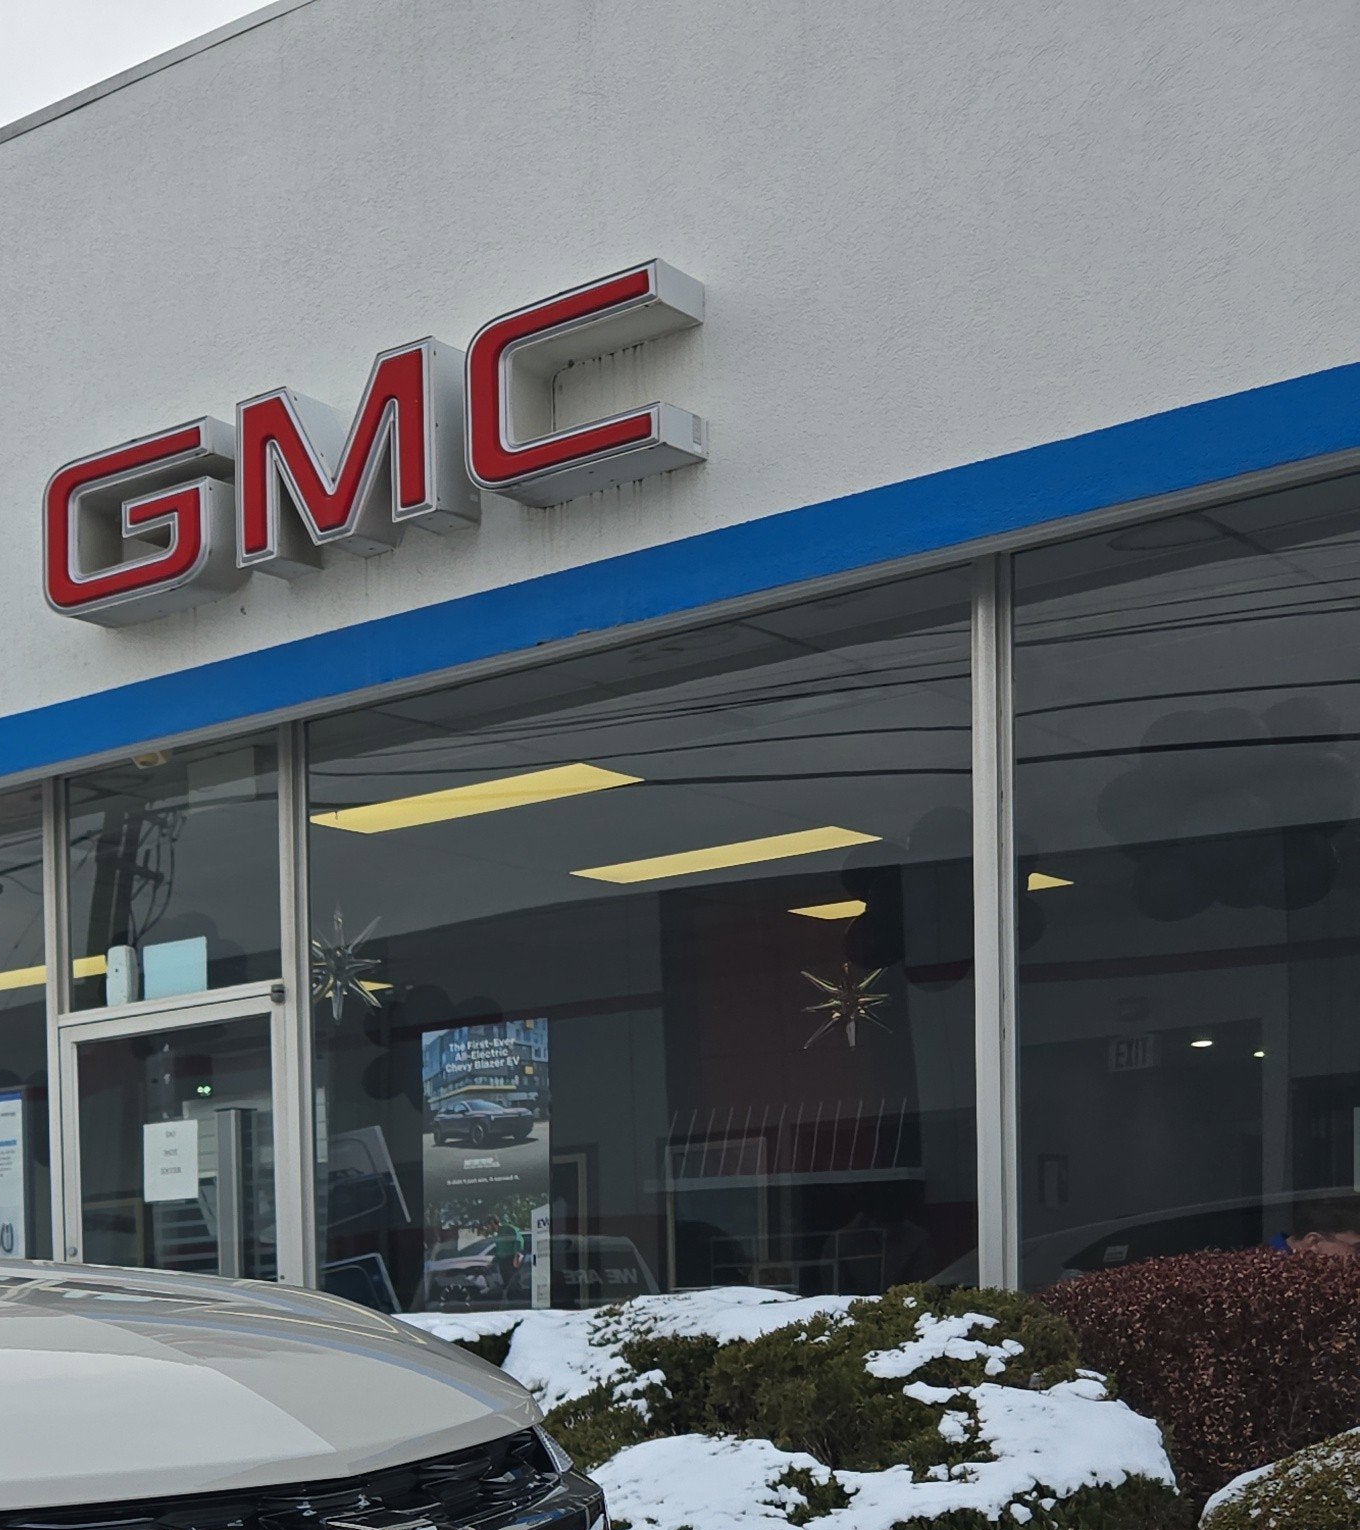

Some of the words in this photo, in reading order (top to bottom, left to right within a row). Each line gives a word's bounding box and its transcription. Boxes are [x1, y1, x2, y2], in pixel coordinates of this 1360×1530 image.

[43, 258, 704, 625] GMC
[449, 1042, 465, 1052] The
[467, 1038, 516, 1049] First-Ever
[455, 1050, 509, 1062] All-Electric
[445, 1062, 472, 1073] Chevy
[474, 1059, 505, 1069] Blazer
[507, 1056, 520, 1066] EV
